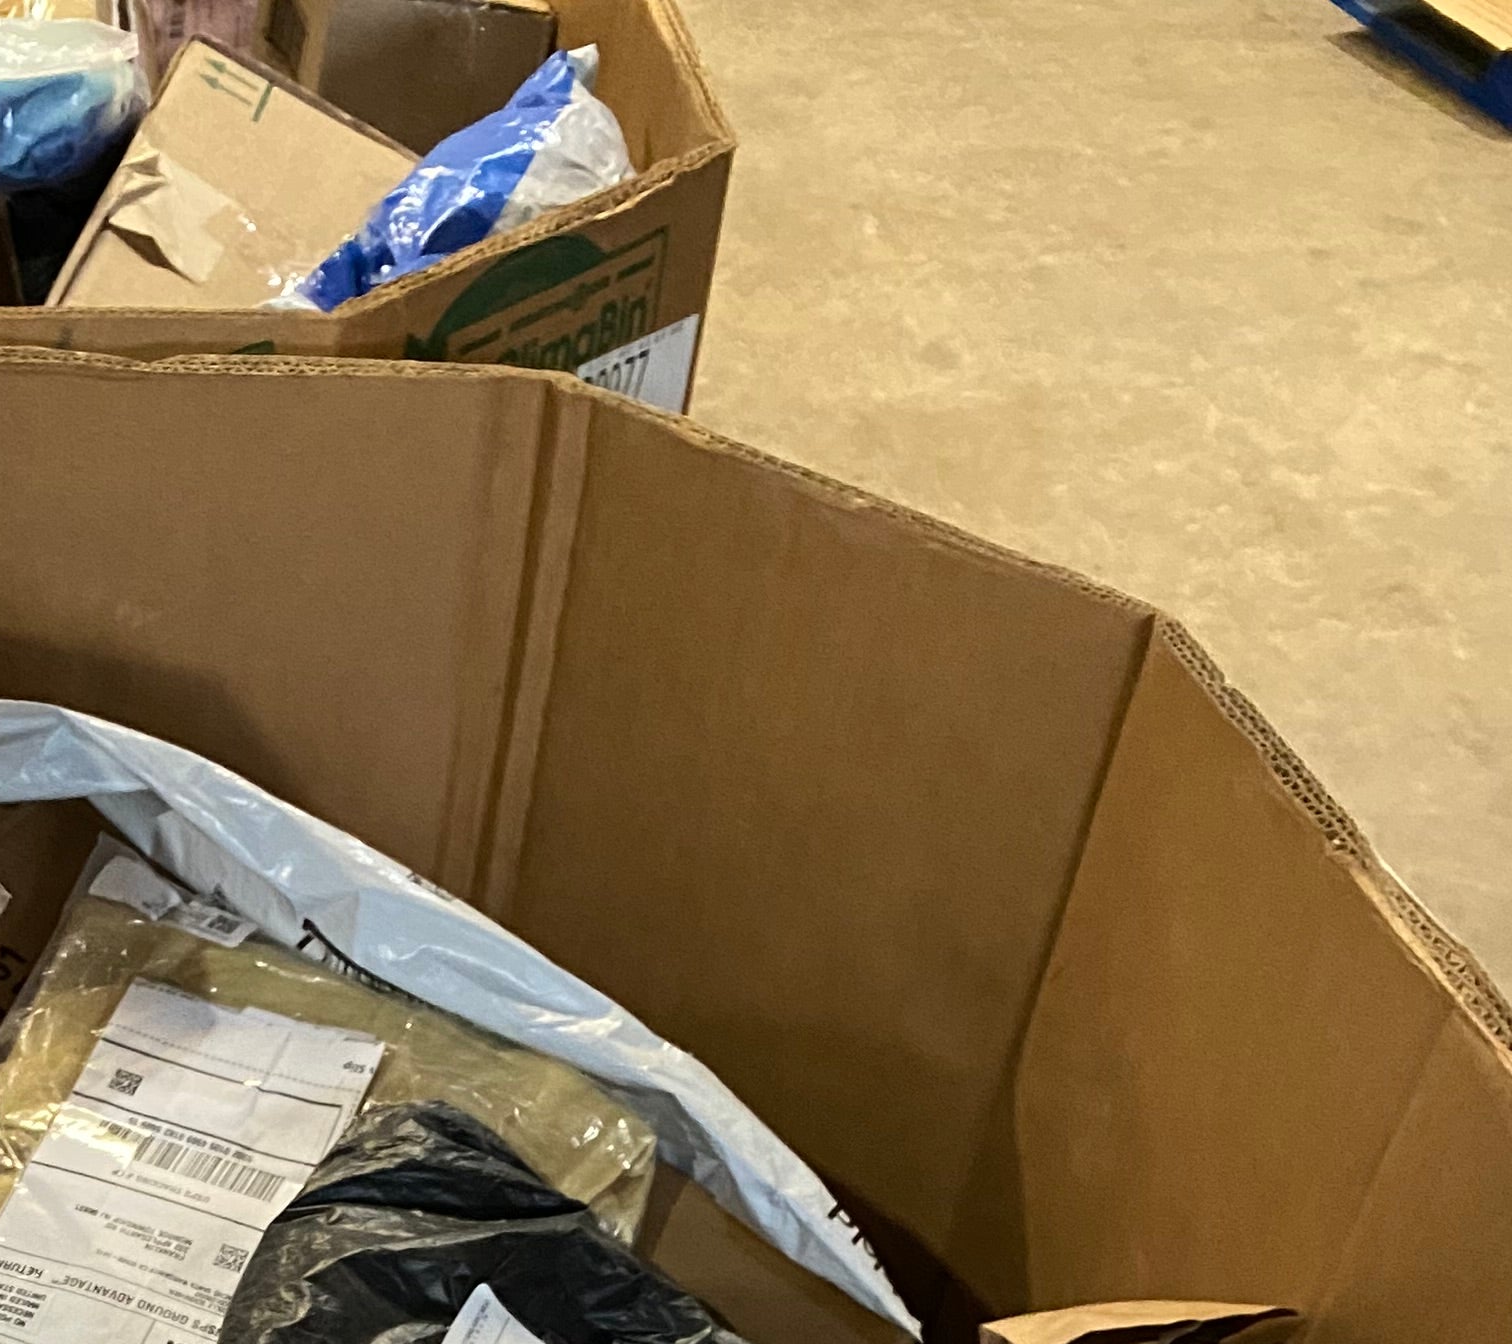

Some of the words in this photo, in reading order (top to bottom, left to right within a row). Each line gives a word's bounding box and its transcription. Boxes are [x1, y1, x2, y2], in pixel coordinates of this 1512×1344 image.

[16, 1287, 46, 1302] UNITED
[9, 1295, 40, 1310] MAILED
[135, 1298, 190, 1325] GROUND
